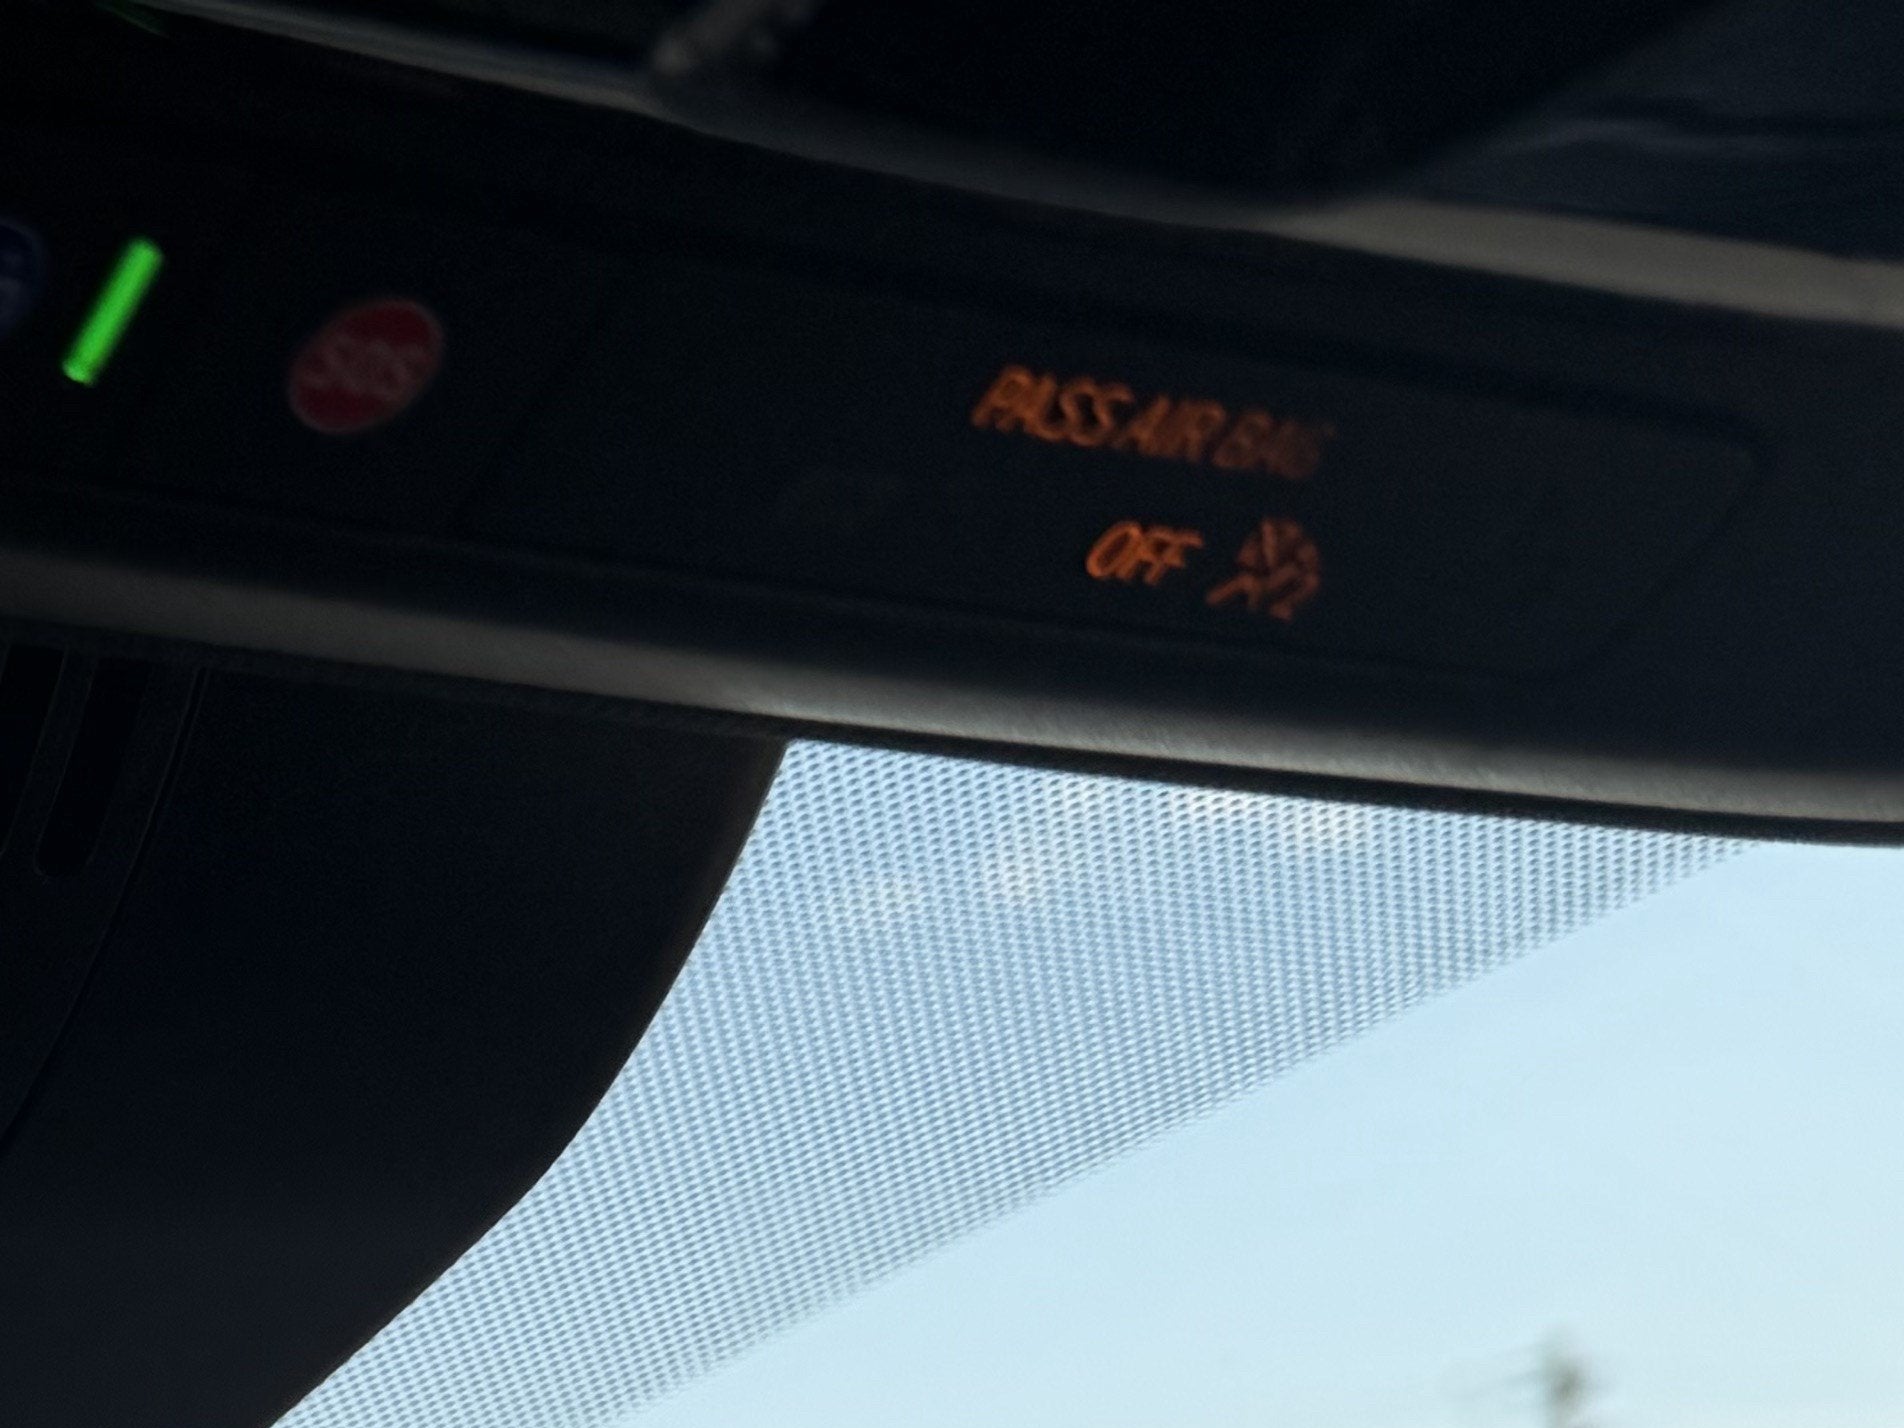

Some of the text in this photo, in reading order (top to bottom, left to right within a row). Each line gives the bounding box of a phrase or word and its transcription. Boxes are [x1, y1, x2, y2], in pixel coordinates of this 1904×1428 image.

[298, 331, 436, 402] SOS
[967, 363, 1137, 449] PASS
[1122, 391, 1230, 466] AIR
[1083, 518, 1206, 587] OFF
